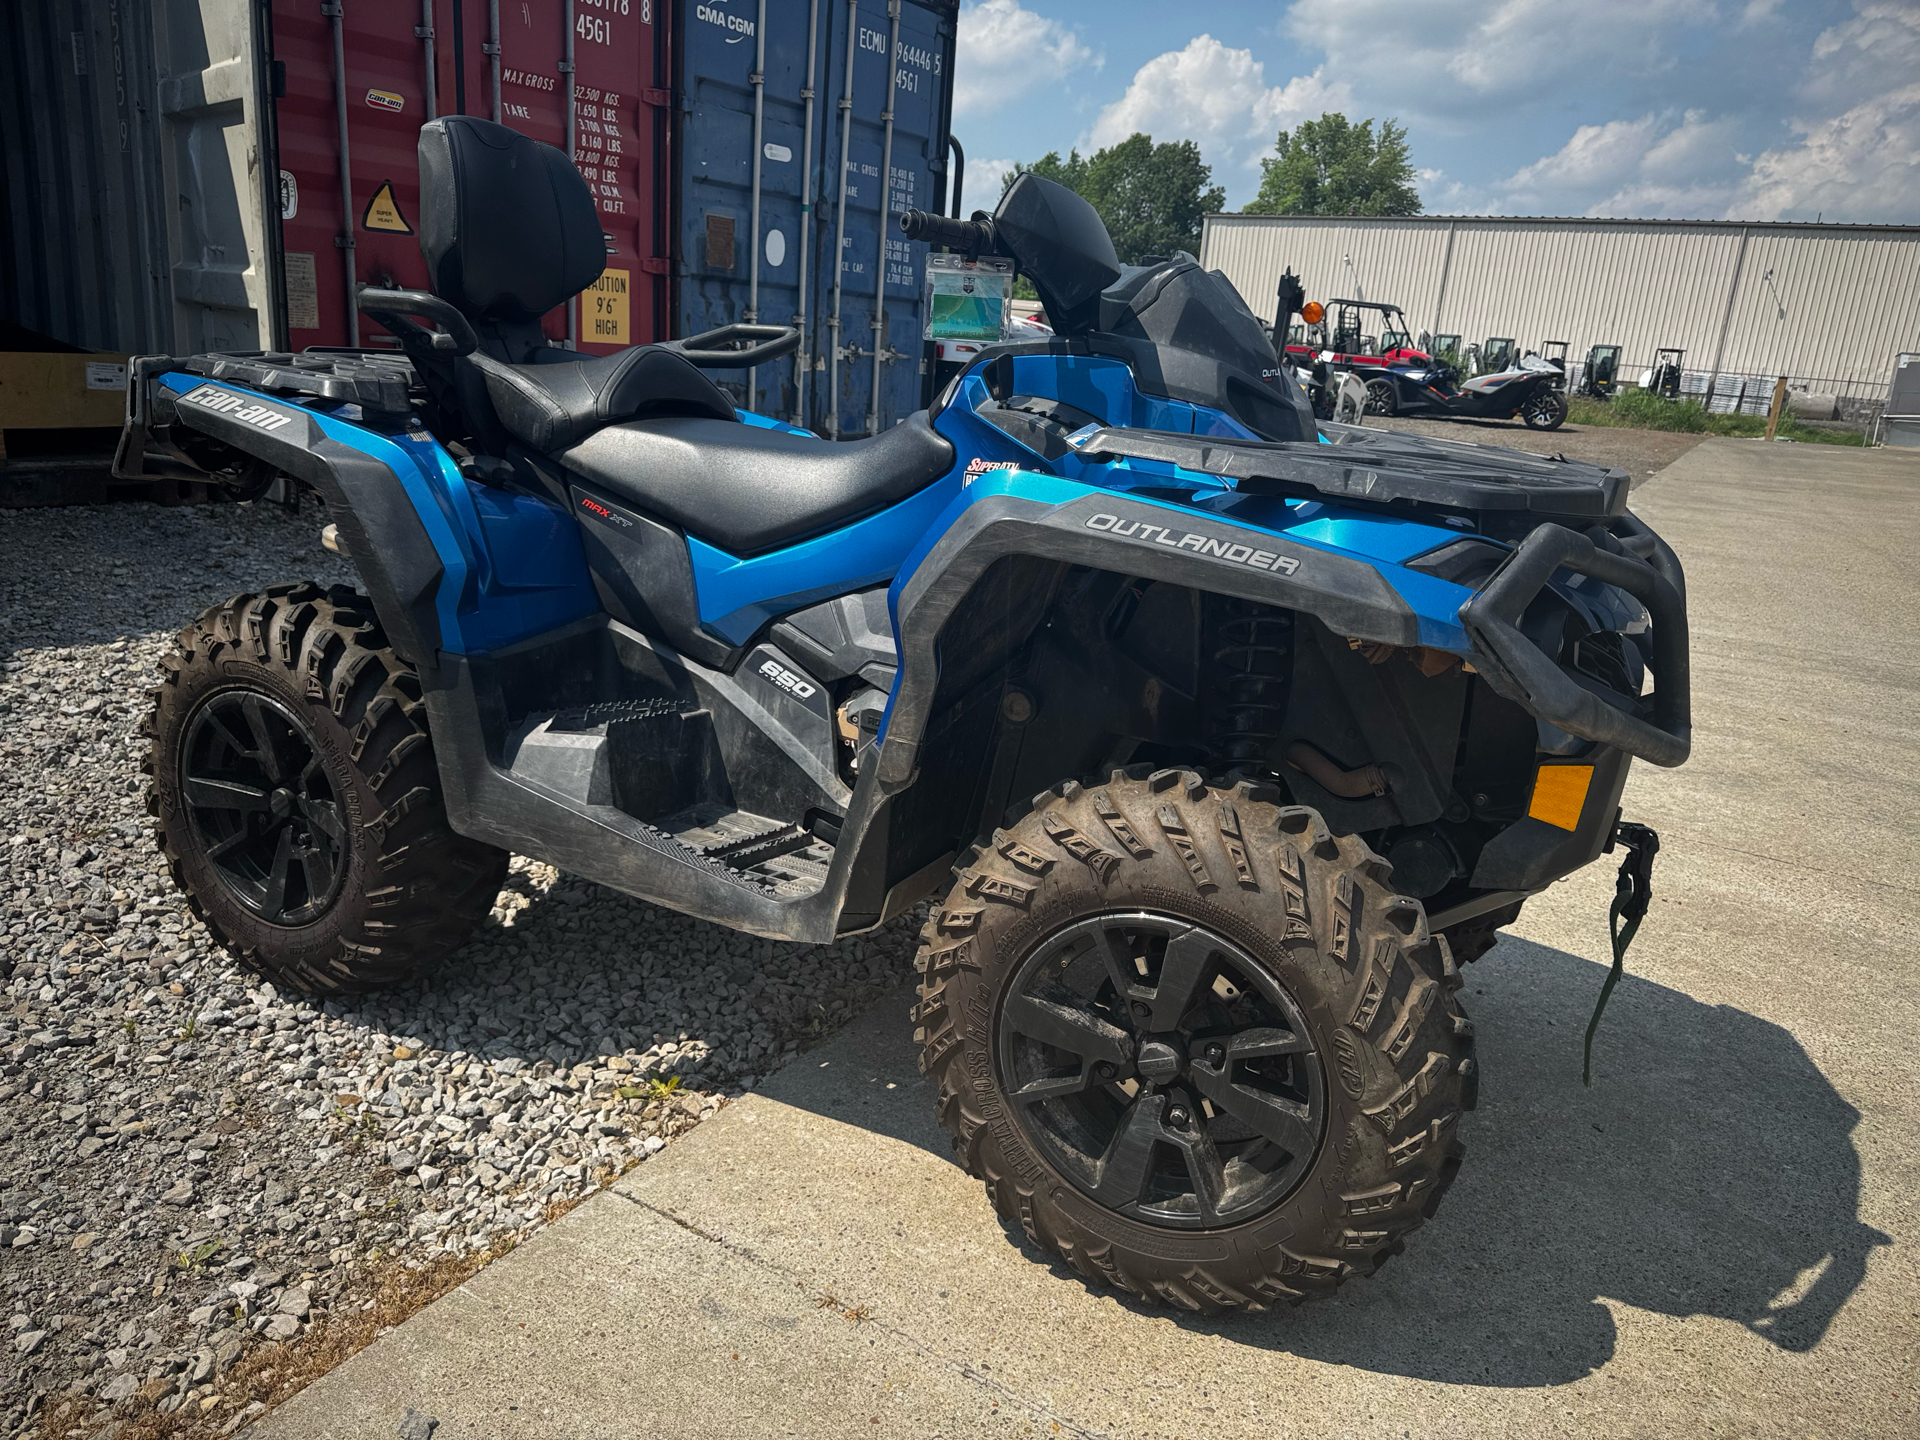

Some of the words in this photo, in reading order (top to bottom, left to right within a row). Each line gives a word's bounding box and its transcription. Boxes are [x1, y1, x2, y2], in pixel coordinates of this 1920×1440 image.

[576, 14, 610, 45] 45G1
[697, 5, 726, 27] CMA
[728, 15, 754, 36] CGM
[860, 27, 886, 54] ECMU
[897, 42, 930, 71] 964446
[934, 54, 940, 74] 5
[503, 69, 523, 85] MAX
[525, 73, 555, 91] GROSS
[574, 86, 600, 101] 32.500
[896, 69, 918, 93] 45G1
[368, 93, 402, 108] can-am
[503, 103, 531, 120] TARE
[602, 108, 619, 123] LBS.
[582, 134, 601, 149] 8.160
[607, 139, 623, 153] LBS.
[602, 170, 618, 184] LBS.
[595, 319, 617, 335] HIGH
[185, 387, 292, 431] can-am
[581, 499, 611, 517] MAX
[609, 514, 633, 527] XT
[1085, 513, 1300, 576] OUTLANDER
[759, 669, 791, 692] V-TWIN
[761, 660, 816, 698] 650
[322, 734, 353, 788] TERRA
[346, 790, 366, 851] CROSS
[966, 1049, 1004, 1121] CROSS
[986, 1118, 1045, 1188] TERRA
